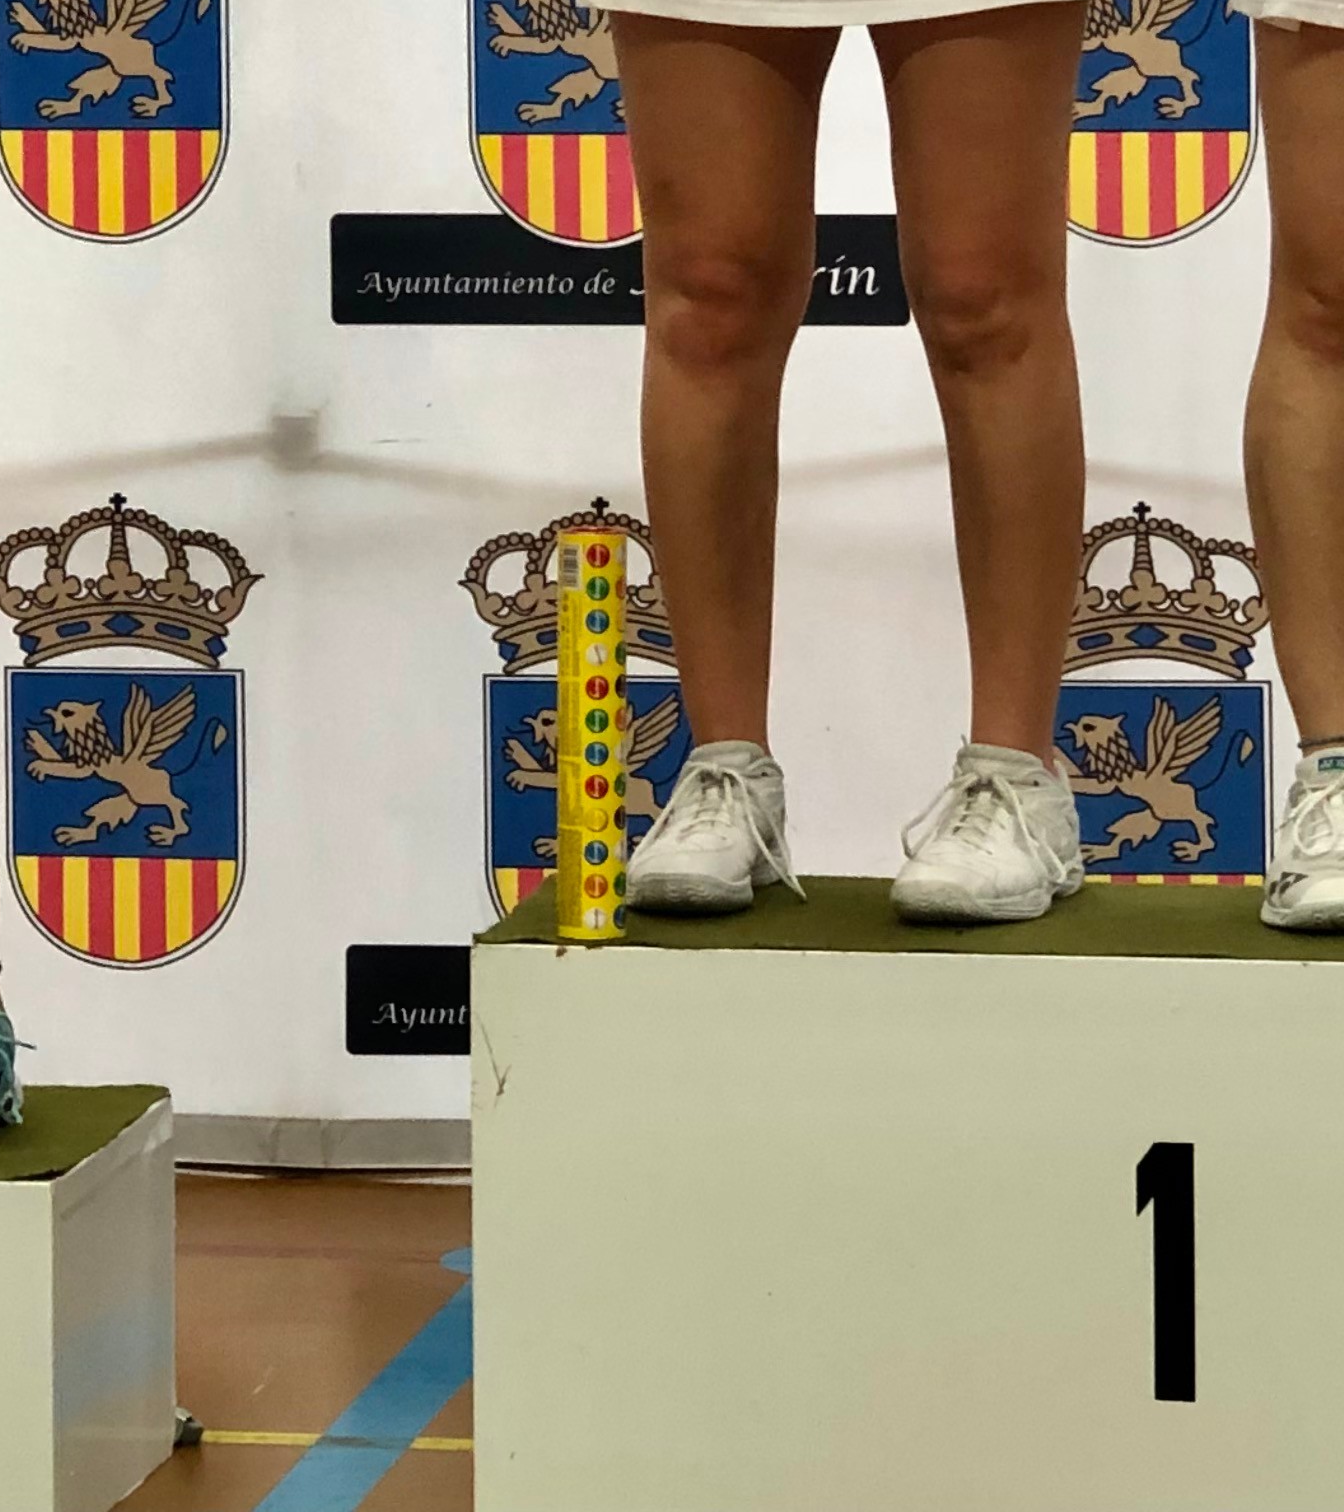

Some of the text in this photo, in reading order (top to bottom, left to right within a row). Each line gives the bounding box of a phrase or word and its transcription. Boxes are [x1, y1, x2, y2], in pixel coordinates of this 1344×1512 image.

[357, 271, 575, 303] Ayuntamiento
[583, 268, 616, 296] de
[1136, 1141, 1196, 1403] 1
